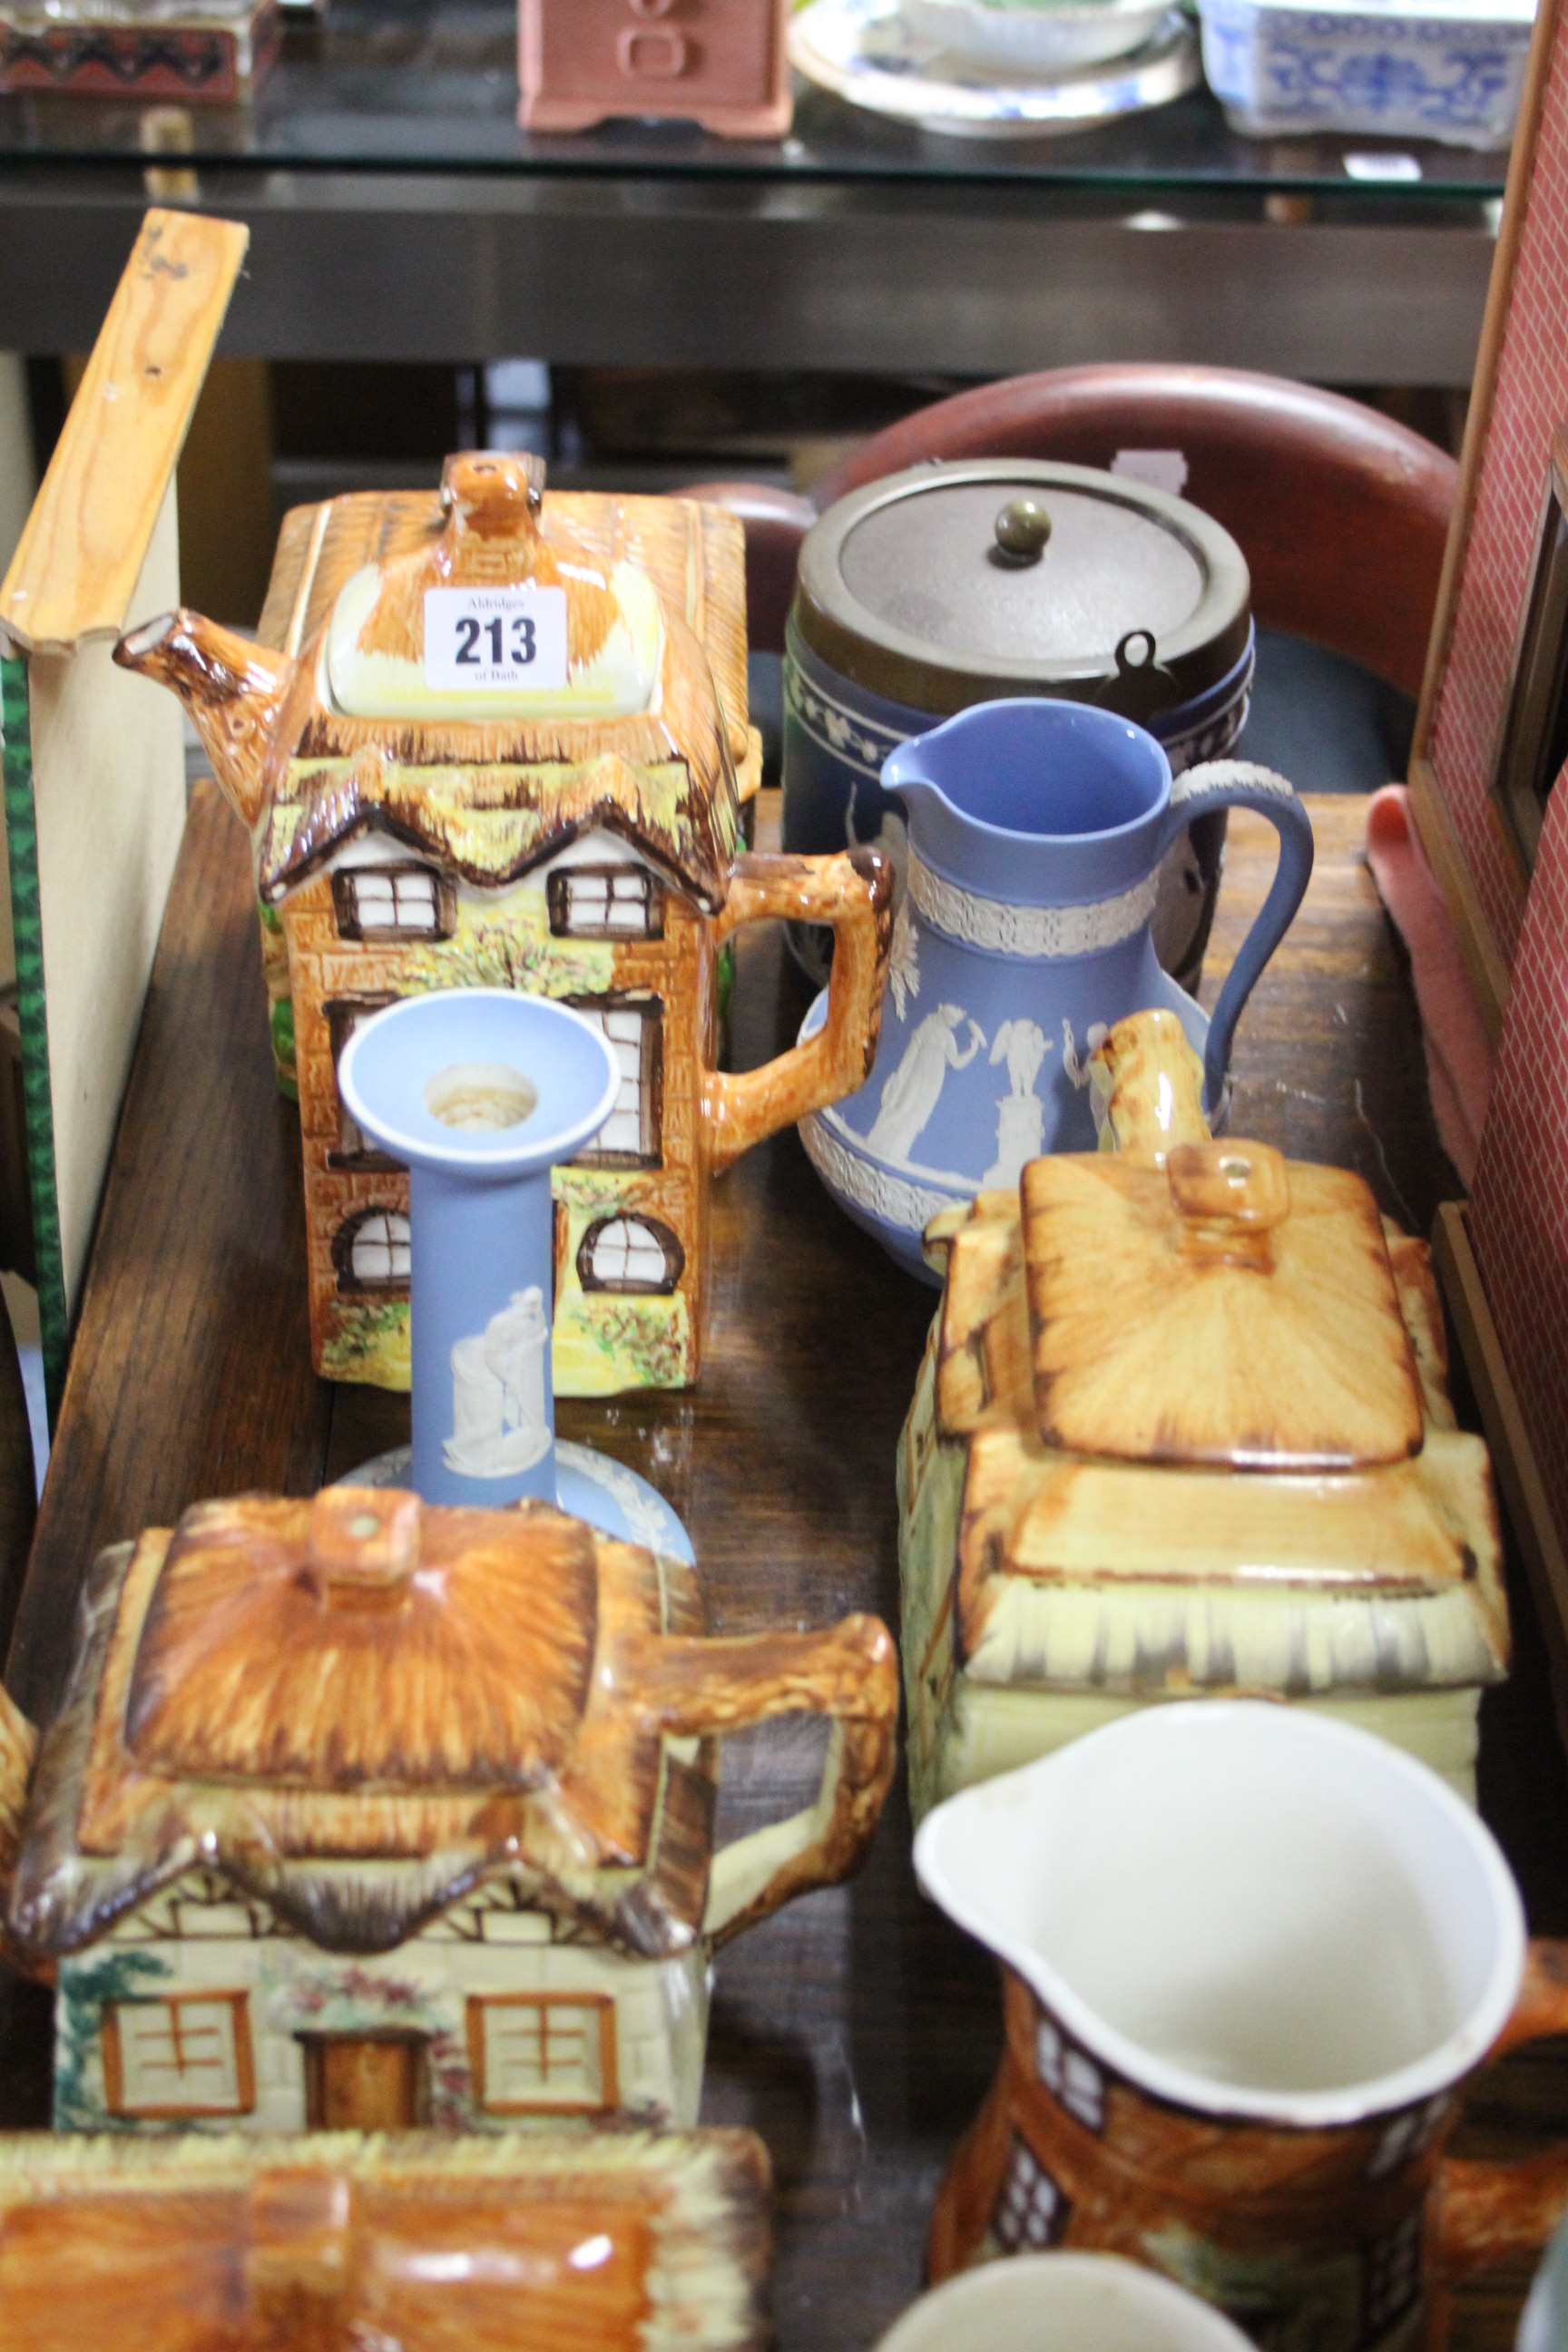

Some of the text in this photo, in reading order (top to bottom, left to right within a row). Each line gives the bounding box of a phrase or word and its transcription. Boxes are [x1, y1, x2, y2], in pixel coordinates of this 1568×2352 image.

[468, 597, 524, 611] Aldridges
[456, 617, 536, 664] 213
[475, 670, 486, 681] of
